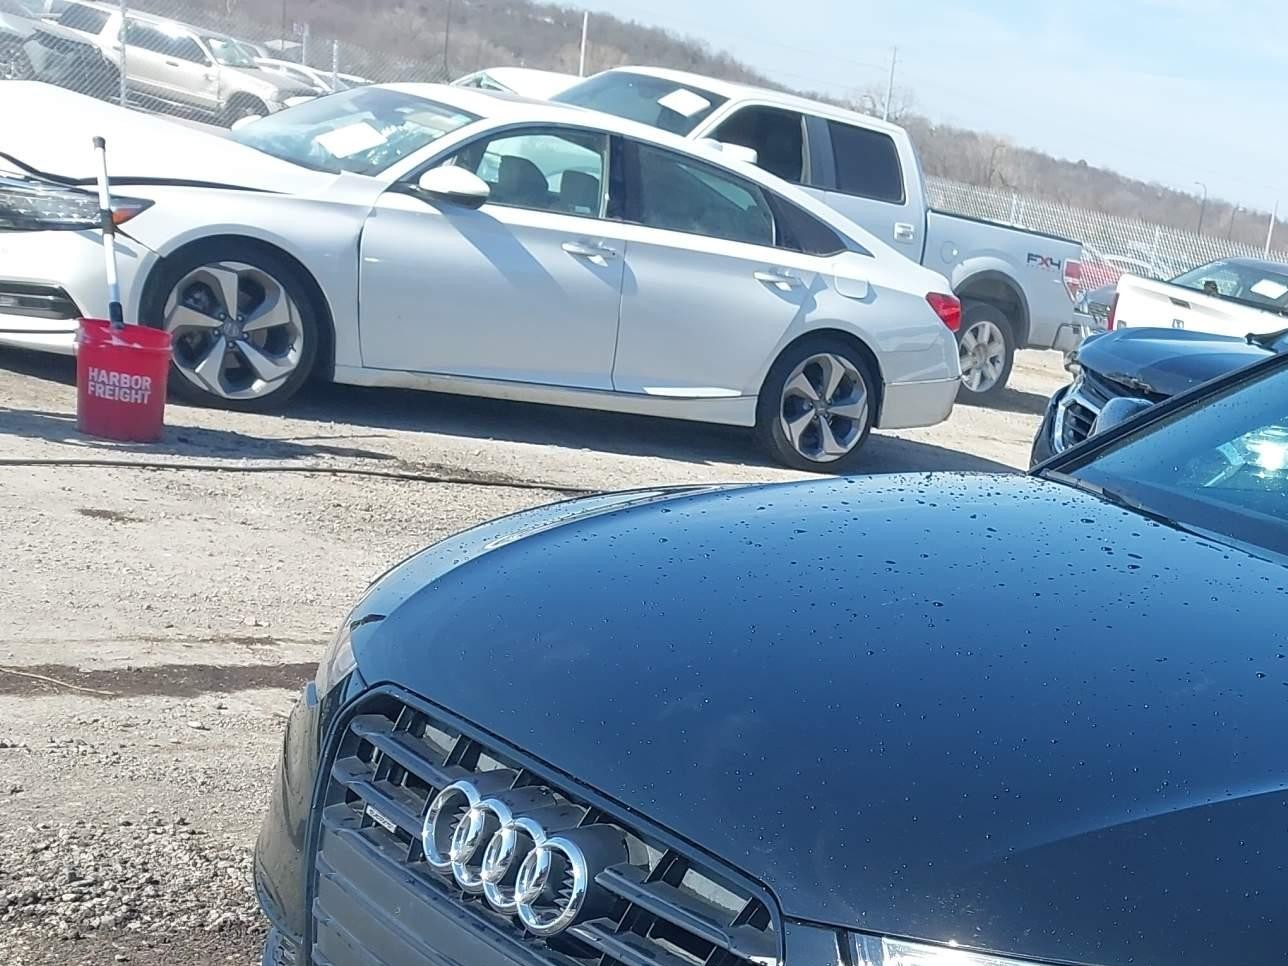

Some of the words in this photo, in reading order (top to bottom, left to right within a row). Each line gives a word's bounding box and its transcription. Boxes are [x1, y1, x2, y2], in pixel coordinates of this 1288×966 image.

[1027, 252, 1061, 270] FX4
[87, 366, 152, 390] HARBOR
[87, 381, 152, 405] FREIGHT
